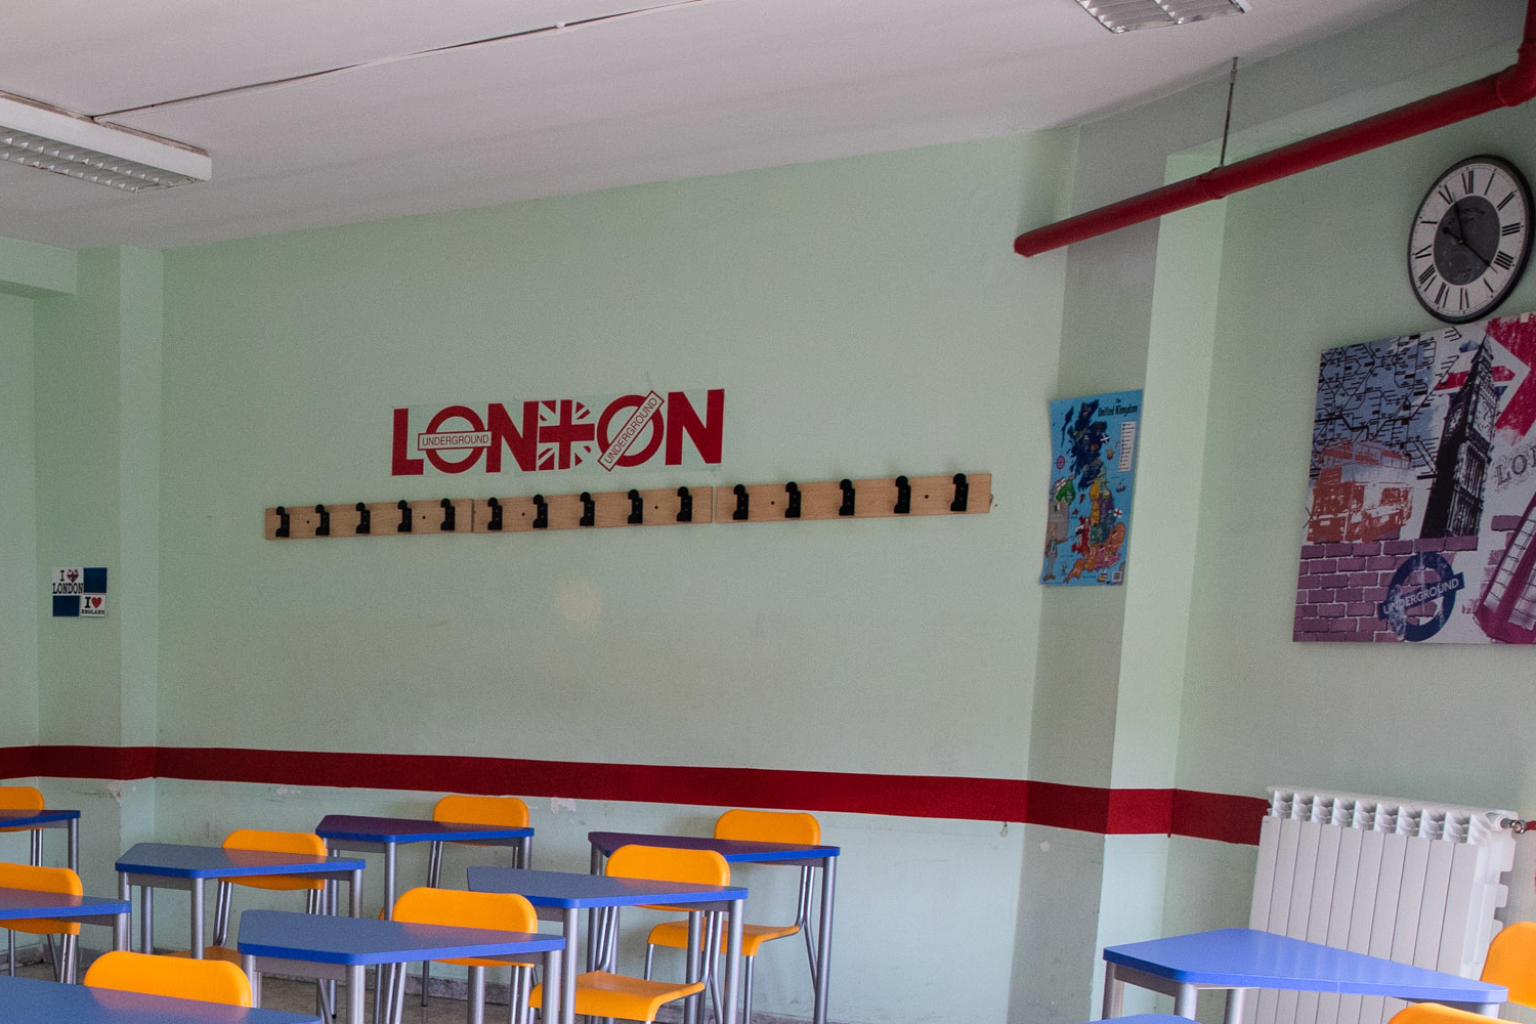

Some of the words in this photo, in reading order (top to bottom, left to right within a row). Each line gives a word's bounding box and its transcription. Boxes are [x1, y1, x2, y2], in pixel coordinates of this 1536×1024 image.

[604, 397, 658, 464] UNDERGROUND
[422, 433, 490, 447] UNDERGROUND
[60, 570, 65, 582] I
[52, 582, 84, 594] LONDON
[84, 596, 91, 608] I
[1383, 578, 1460, 615] UNDERGROUND
